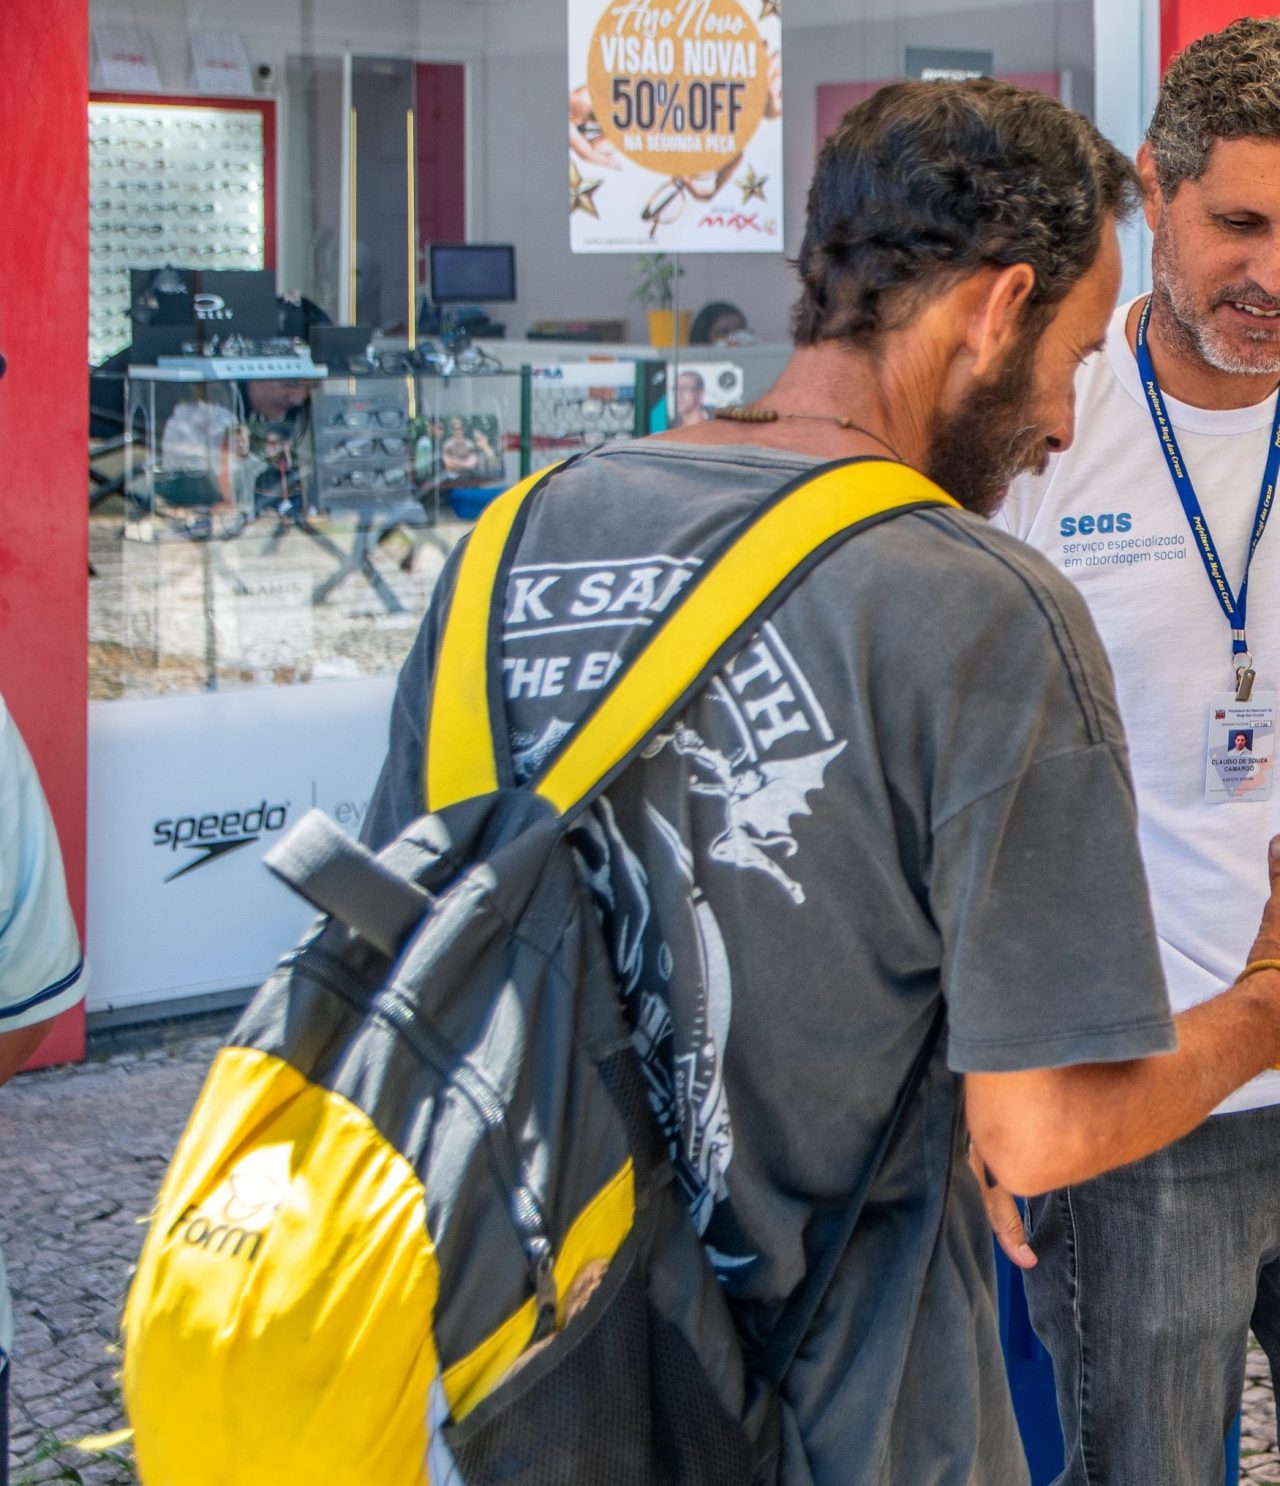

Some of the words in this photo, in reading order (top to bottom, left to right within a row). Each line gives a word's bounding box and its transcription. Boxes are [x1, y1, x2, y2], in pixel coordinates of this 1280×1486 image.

[600, 30, 675, 75] VISÃO
[682, 38, 758, 79] NOVA!
[623, 134, 643, 153] NA
[1060, 512, 1133, 538] seas
[1062, 540, 1105, 555] serviço
[1107, 533, 1186, 552] especializado
[1064, 556, 1083, 568] em
[1085, 552, 1151, 567] abordagem
[1154, 547, 1187, 561] social
[153, 800, 288, 851] speedo
